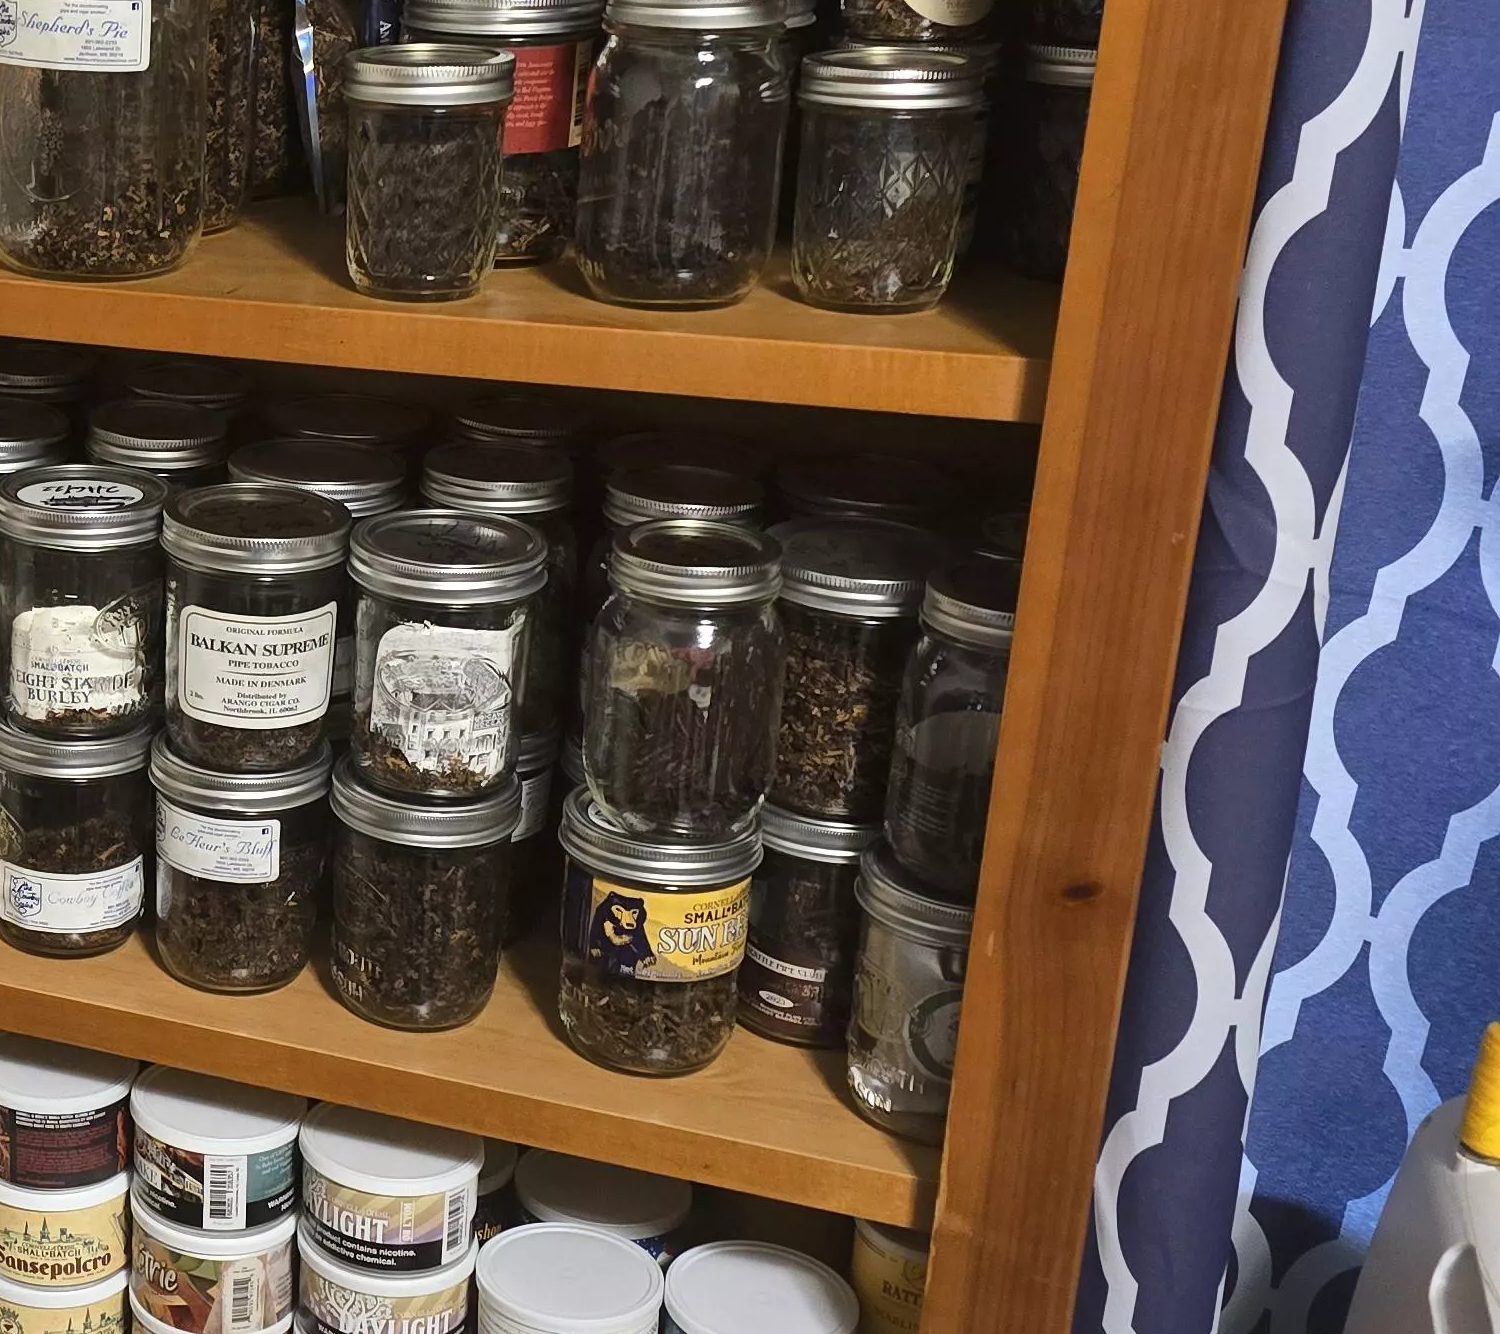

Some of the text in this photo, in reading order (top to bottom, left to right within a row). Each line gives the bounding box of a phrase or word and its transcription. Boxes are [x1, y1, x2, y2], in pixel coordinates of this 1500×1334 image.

[19, 11, 94, 36] Shepherd's
[99, 21, 129, 38] Pie
[226, 627, 304, 636] ORIGINAL FORMULA
[191, 633, 329, 656] BALKAN SUPREME
[228, 660, 299, 669] PIPE TOBACCO
[15, 670, 55, 688] EIGHT
[216, 676, 307, 687] MADE IN DENMARK
[28, 687, 93, 703] BURLEY
[237, 692, 287, 701] Distributed by
[259, 699, 286, 707] CIGAR
[236, 840, 277, 858] Bluff
[47, 891, 98, 908] Cowboy
[684, 910, 727, 924] SMALL
[658, 926, 719, 954] SUN
[17, 1246, 81, 1258] SMALL BATCH
[322, 1239, 397, 1266] addictive chemical.
[342, 1240, 417, 1257] contains nicotine.
